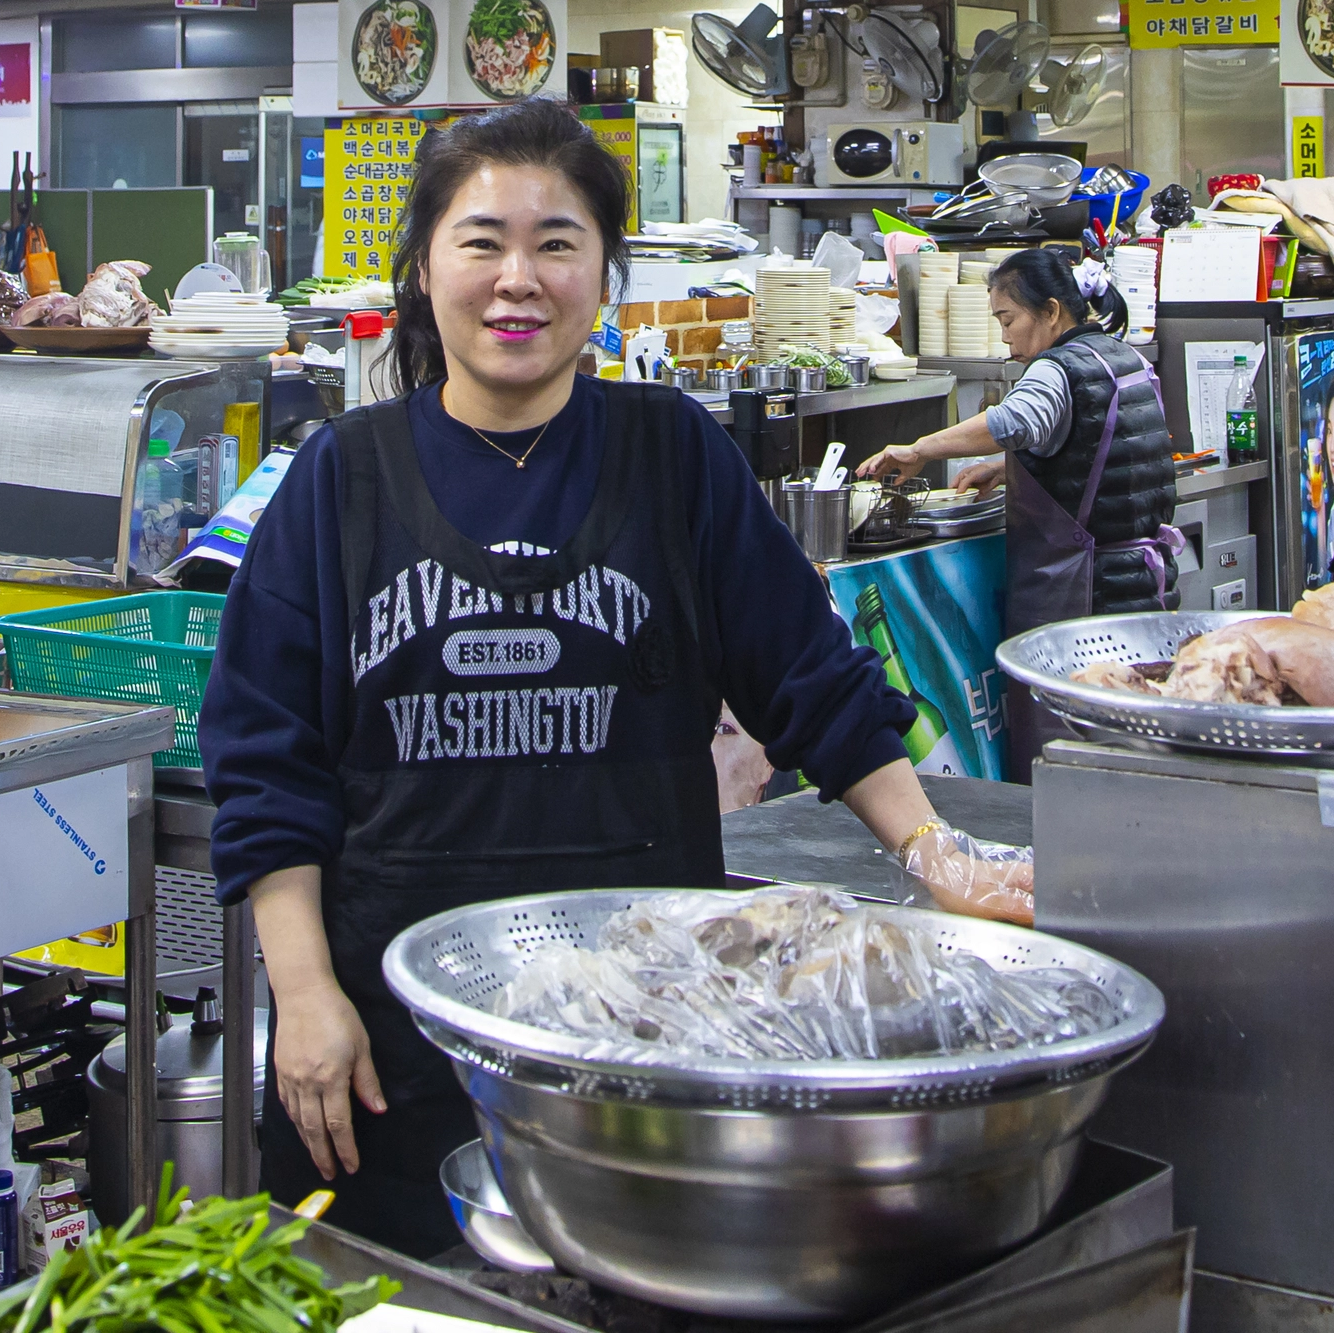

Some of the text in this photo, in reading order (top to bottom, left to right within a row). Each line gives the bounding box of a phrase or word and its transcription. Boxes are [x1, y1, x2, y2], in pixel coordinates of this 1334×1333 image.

[1146, 14, 1259, 37] 야채닭갈비
[345, 121, 422, 137] 소머리국밥
[343, 162, 415, 180] 순대곱창볶
[384, 685, 619, 763] WASHINGTON
[32, 787, 97, 862] STAINLESS STEEL
[50, 1219, 86, 1241] 서울우유
